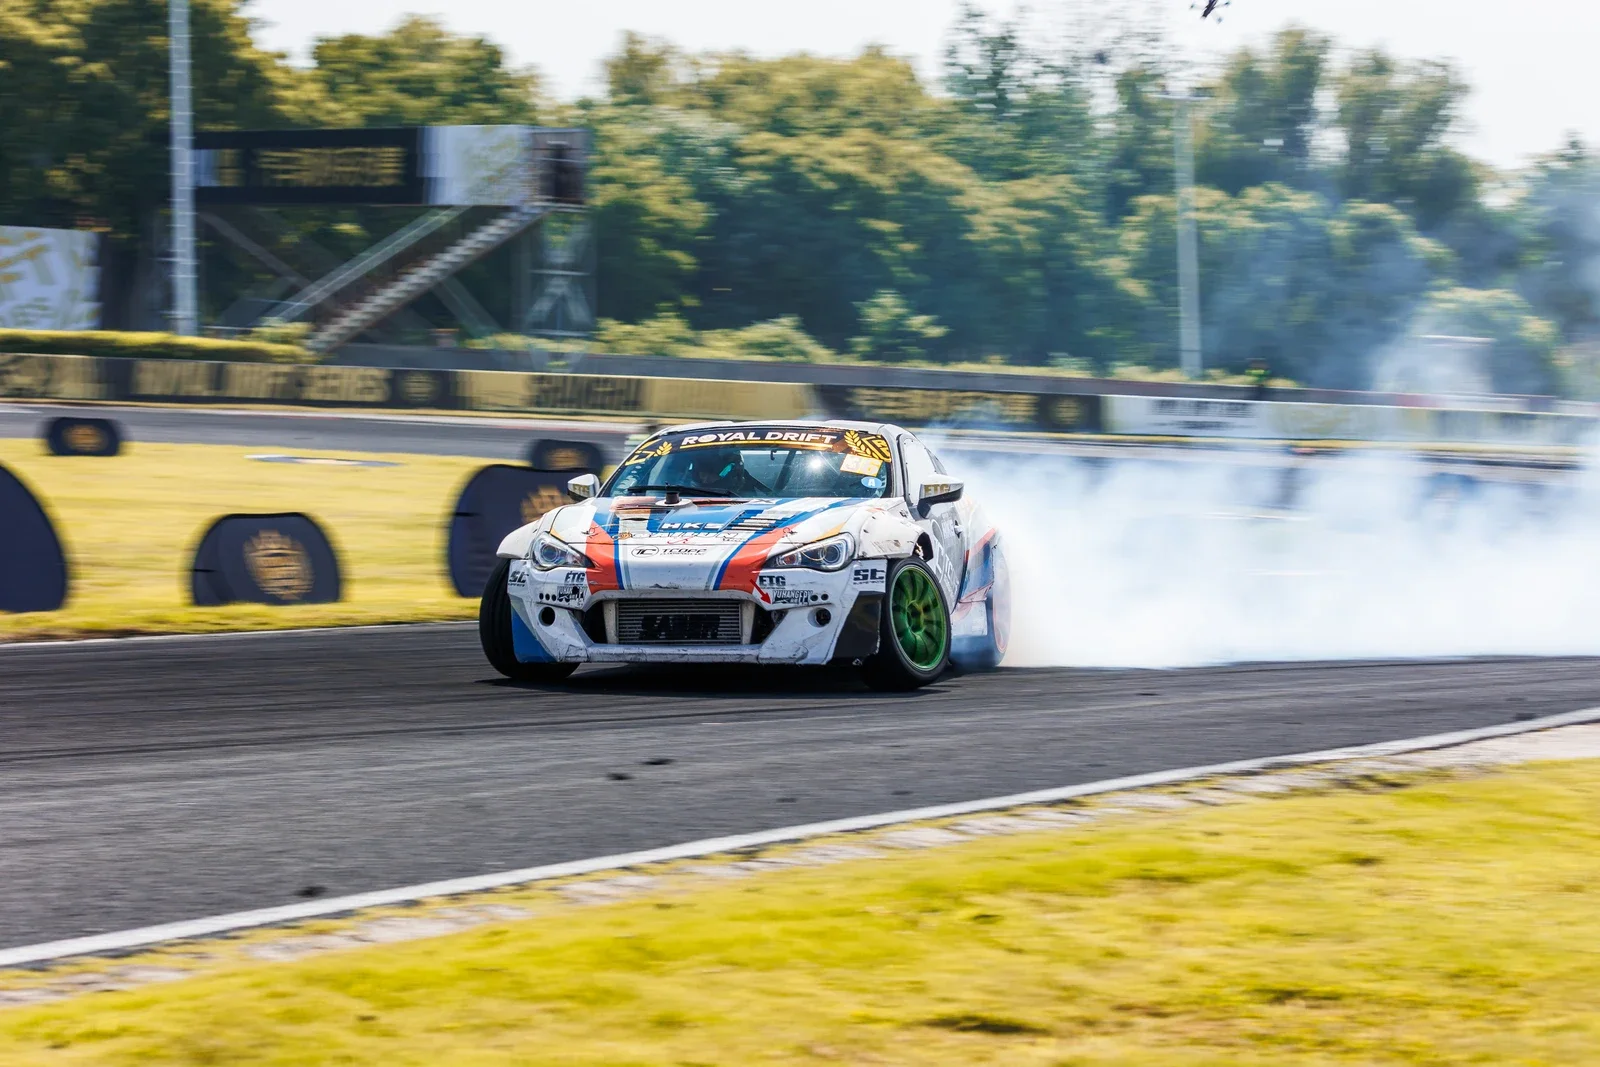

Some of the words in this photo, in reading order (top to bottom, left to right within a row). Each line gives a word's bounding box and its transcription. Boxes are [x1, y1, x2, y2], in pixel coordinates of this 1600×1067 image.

[681, 431, 761, 446] ROYAL
[764, 431, 838, 444] DRIFT
[867, 478, 876, 487] A
[924, 484, 950, 496] ETG
[564, 571, 586, 584] ETG
[759, 575, 786, 587] ETG
